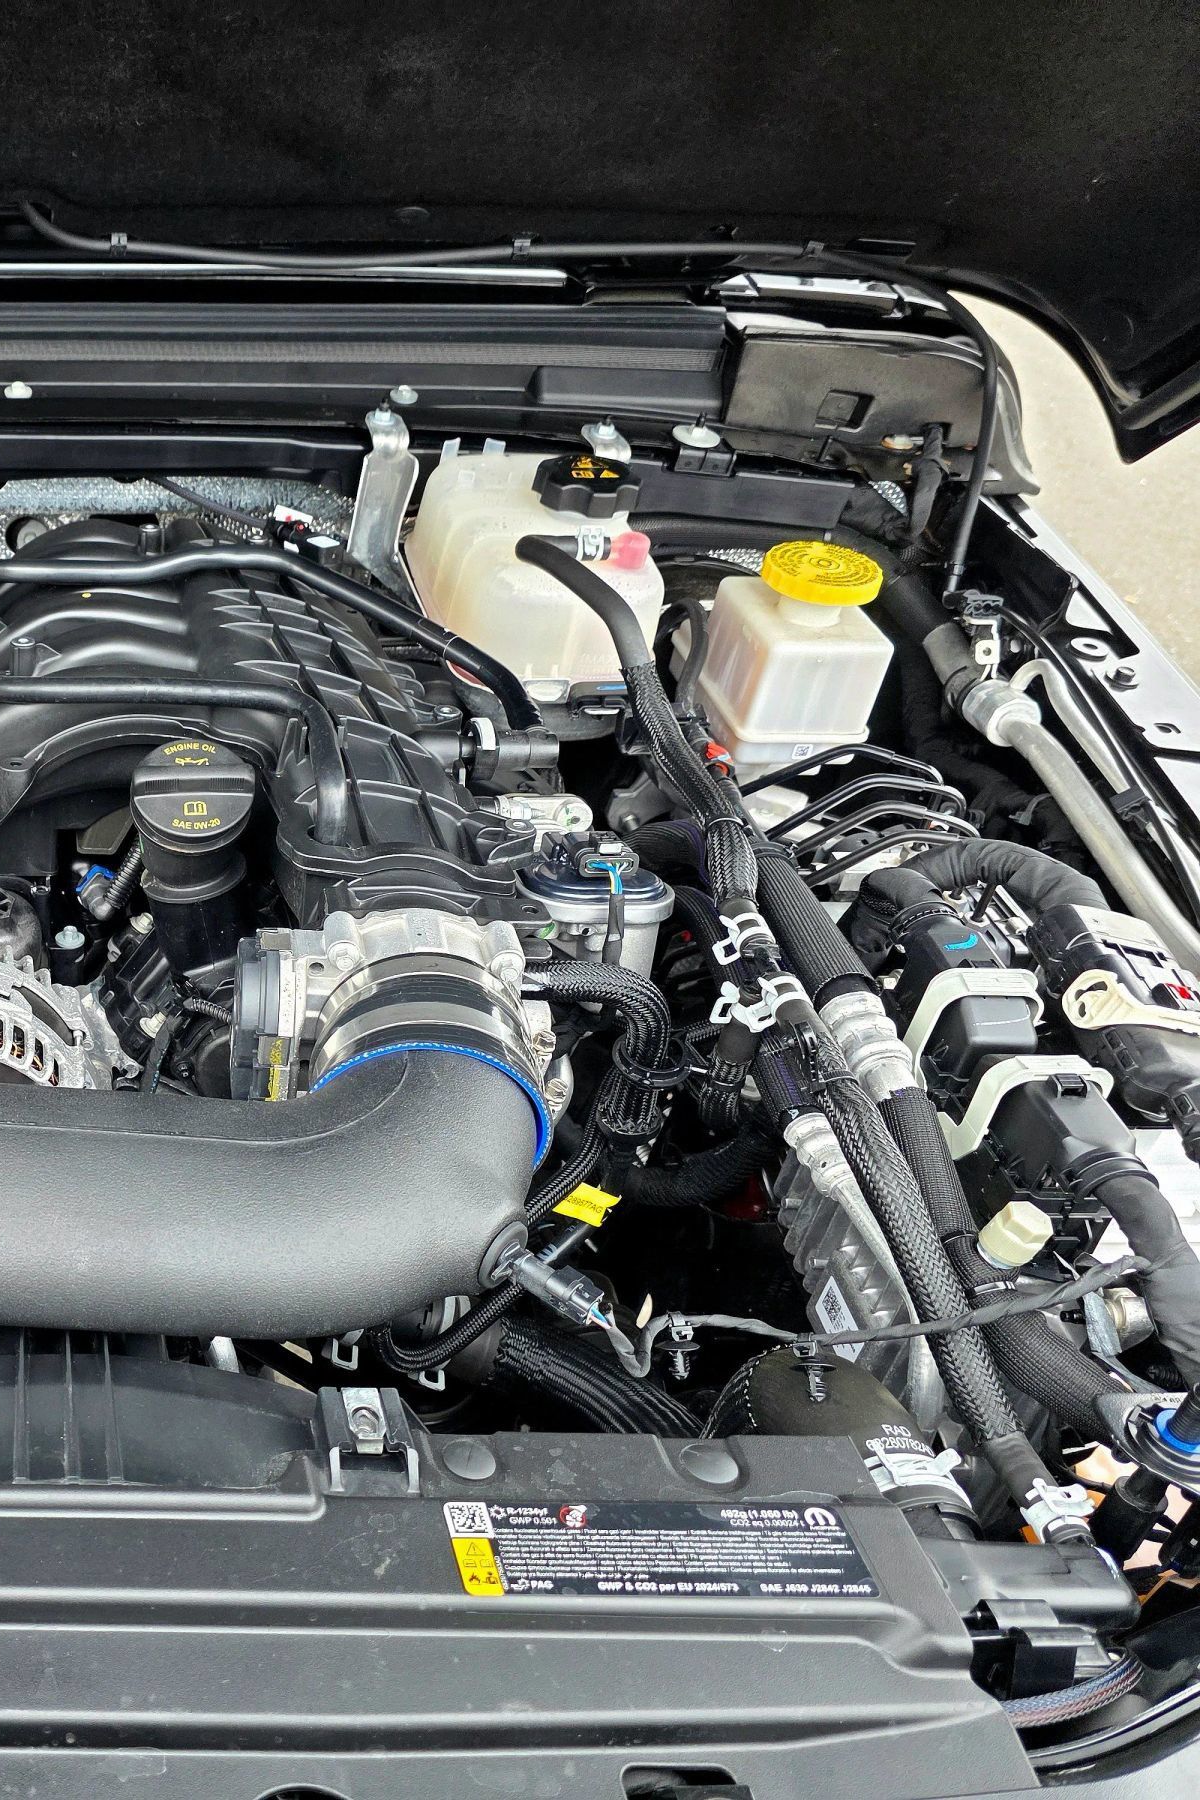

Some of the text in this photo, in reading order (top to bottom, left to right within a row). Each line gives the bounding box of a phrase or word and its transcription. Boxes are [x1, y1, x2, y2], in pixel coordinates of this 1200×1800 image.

[163, 743, 217, 756] ENGINE OIL
[171, 817, 221, 830] SAE 0W-20
[881, 1424, 911, 1438] RAD
[509, 1517, 532, 1525] GWP
[730, 1519, 751, 1527] CO2
[597, 1581, 624, 1592] GWP
[635, 1581, 659, 1592] CO2
[677, 1582, 694, 1592] EU
[759, 1583, 783, 1593] SAE
